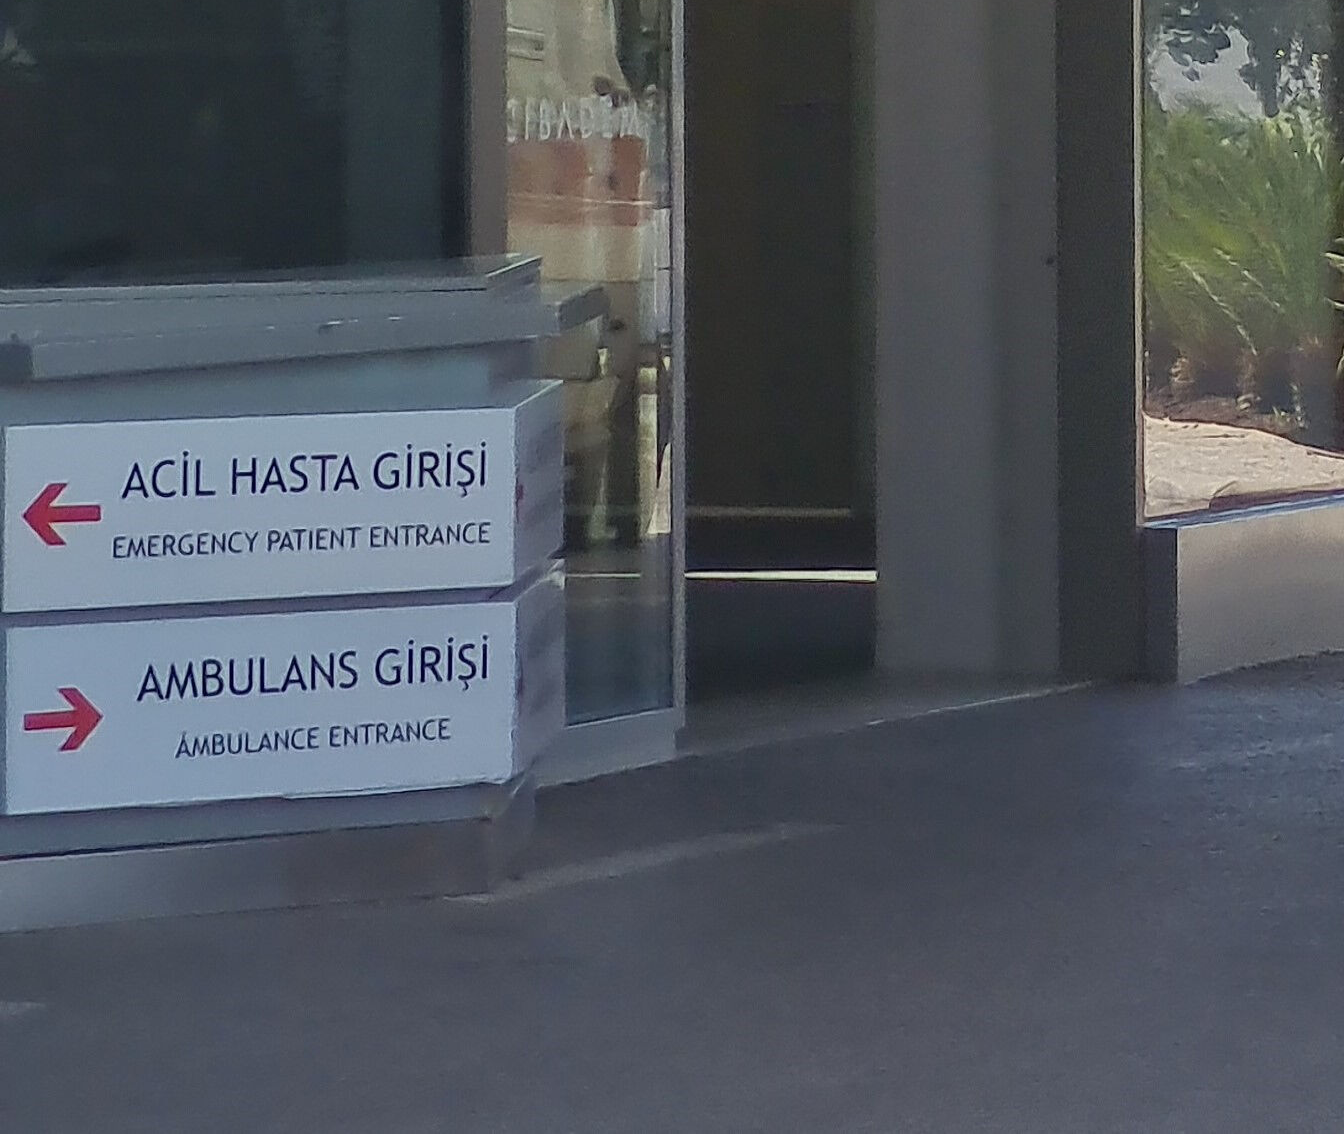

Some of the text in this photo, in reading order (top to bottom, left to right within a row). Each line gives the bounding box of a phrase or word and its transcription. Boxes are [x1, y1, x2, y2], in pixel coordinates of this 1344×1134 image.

[121, 441, 487, 499] ACİL HASTA GİRİŞİ
[112, 521, 491, 559] EMERGENCY PATIENT ENTRANCE
[137, 634, 490, 702] AMBULANS GİRİŞİ
[175, 718, 452, 759] AMBULANCE ENTRANCE
